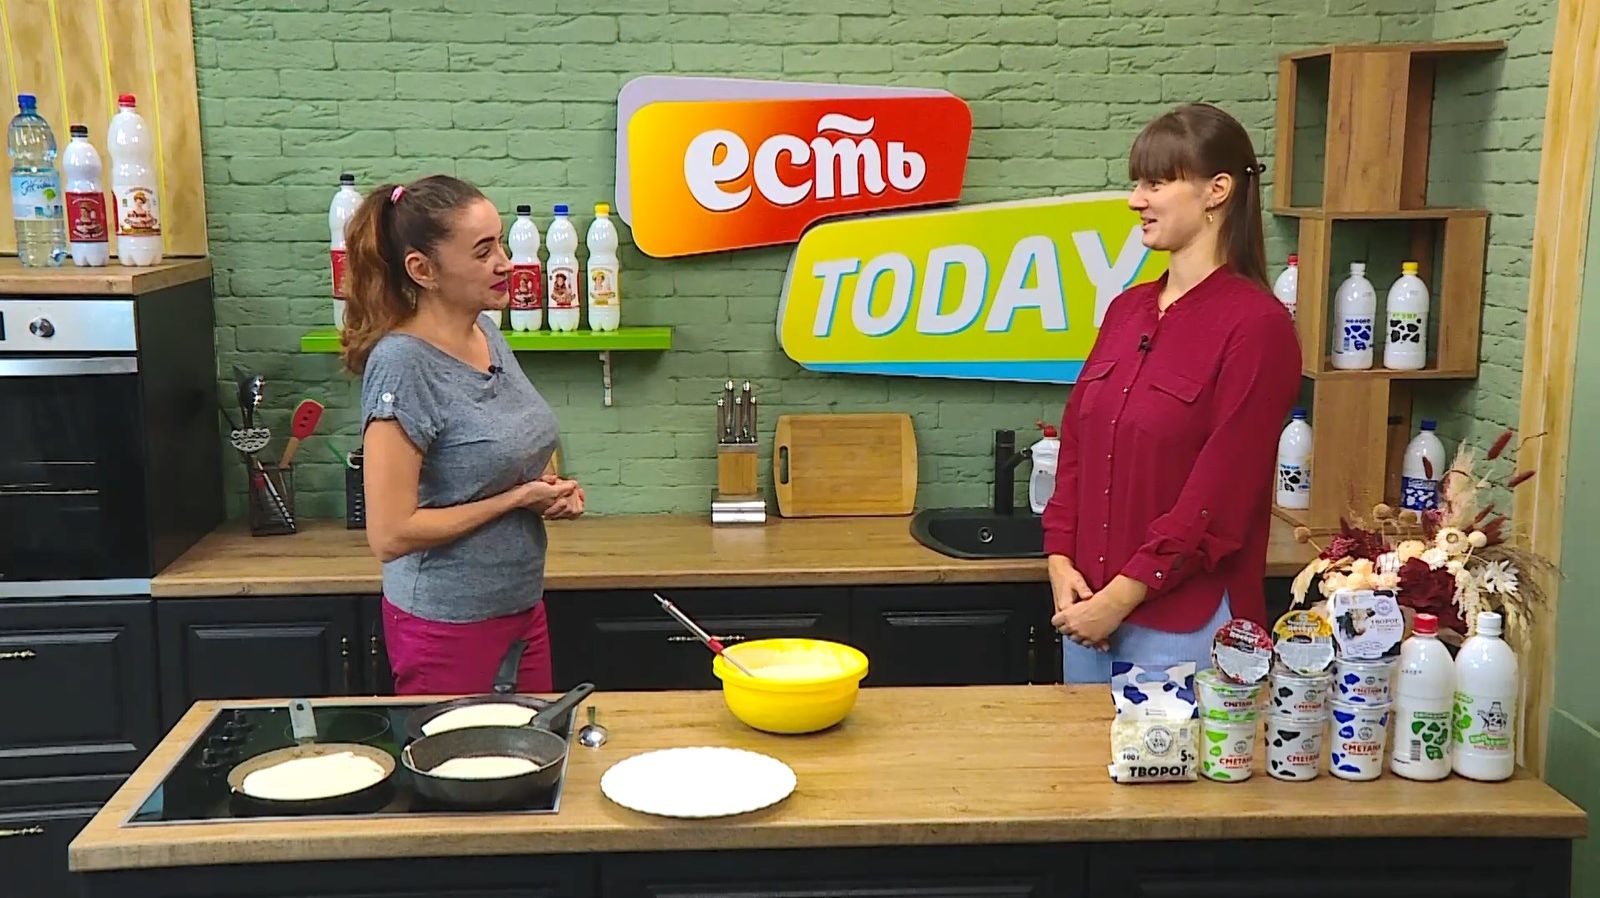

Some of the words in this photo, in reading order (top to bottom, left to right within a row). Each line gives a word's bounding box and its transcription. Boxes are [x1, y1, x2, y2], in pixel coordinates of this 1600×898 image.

[683, 112, 927, 212] есть
[811, 229, 1152, 337] TODAY
[1129, 765, 1187, 777] ТВОРОГ
